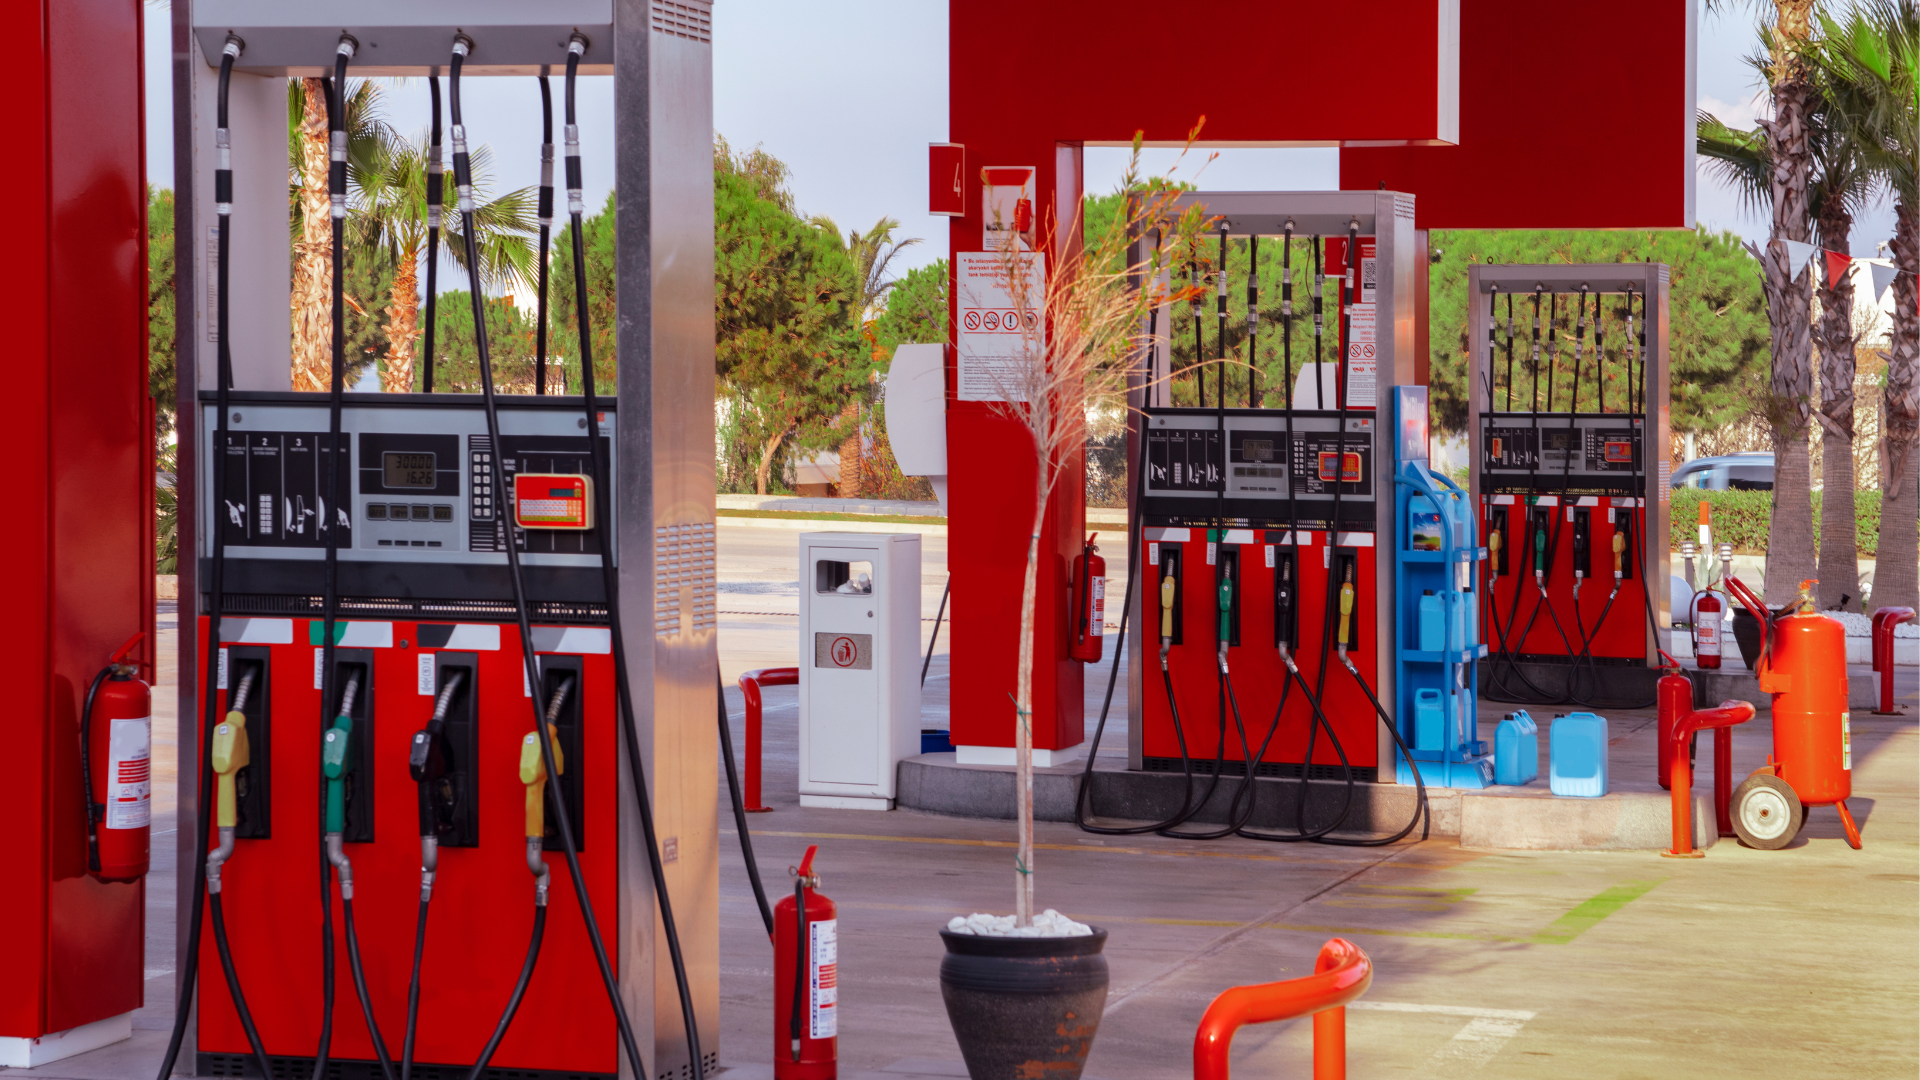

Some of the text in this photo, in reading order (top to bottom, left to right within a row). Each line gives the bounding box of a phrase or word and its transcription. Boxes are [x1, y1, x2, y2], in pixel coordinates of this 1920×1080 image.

[953, 162, 961, 198] 4
[1342, 240, 1347, 265] 2
[262, 437, 268, 446] 2
[296, 438, 302, 446] 3
[396, 455, 432, 469] 300.00
[406, 471, 432, 484] 16.26
